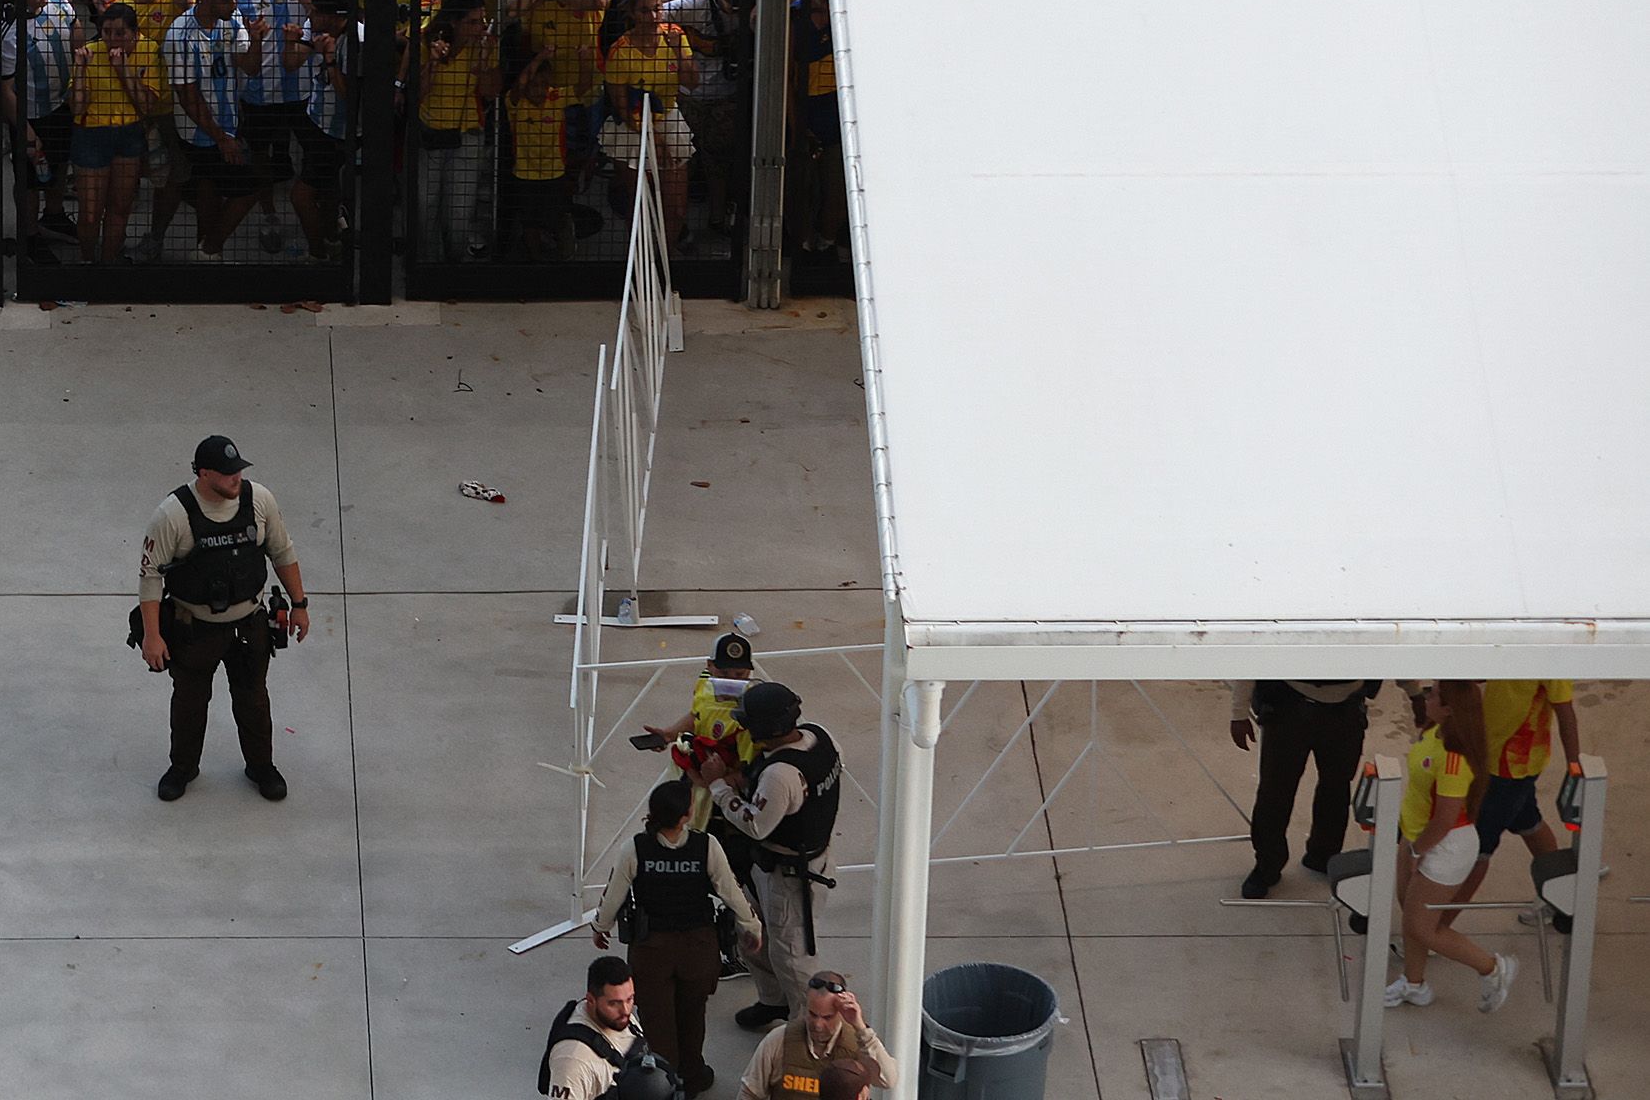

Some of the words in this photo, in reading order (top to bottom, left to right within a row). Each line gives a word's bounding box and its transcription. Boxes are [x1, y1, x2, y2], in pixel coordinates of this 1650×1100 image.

[200, 534, 234, 548] POLICE
[644, 860, 700, 873] POLICE
[551, 1084, 570, 1100] M
